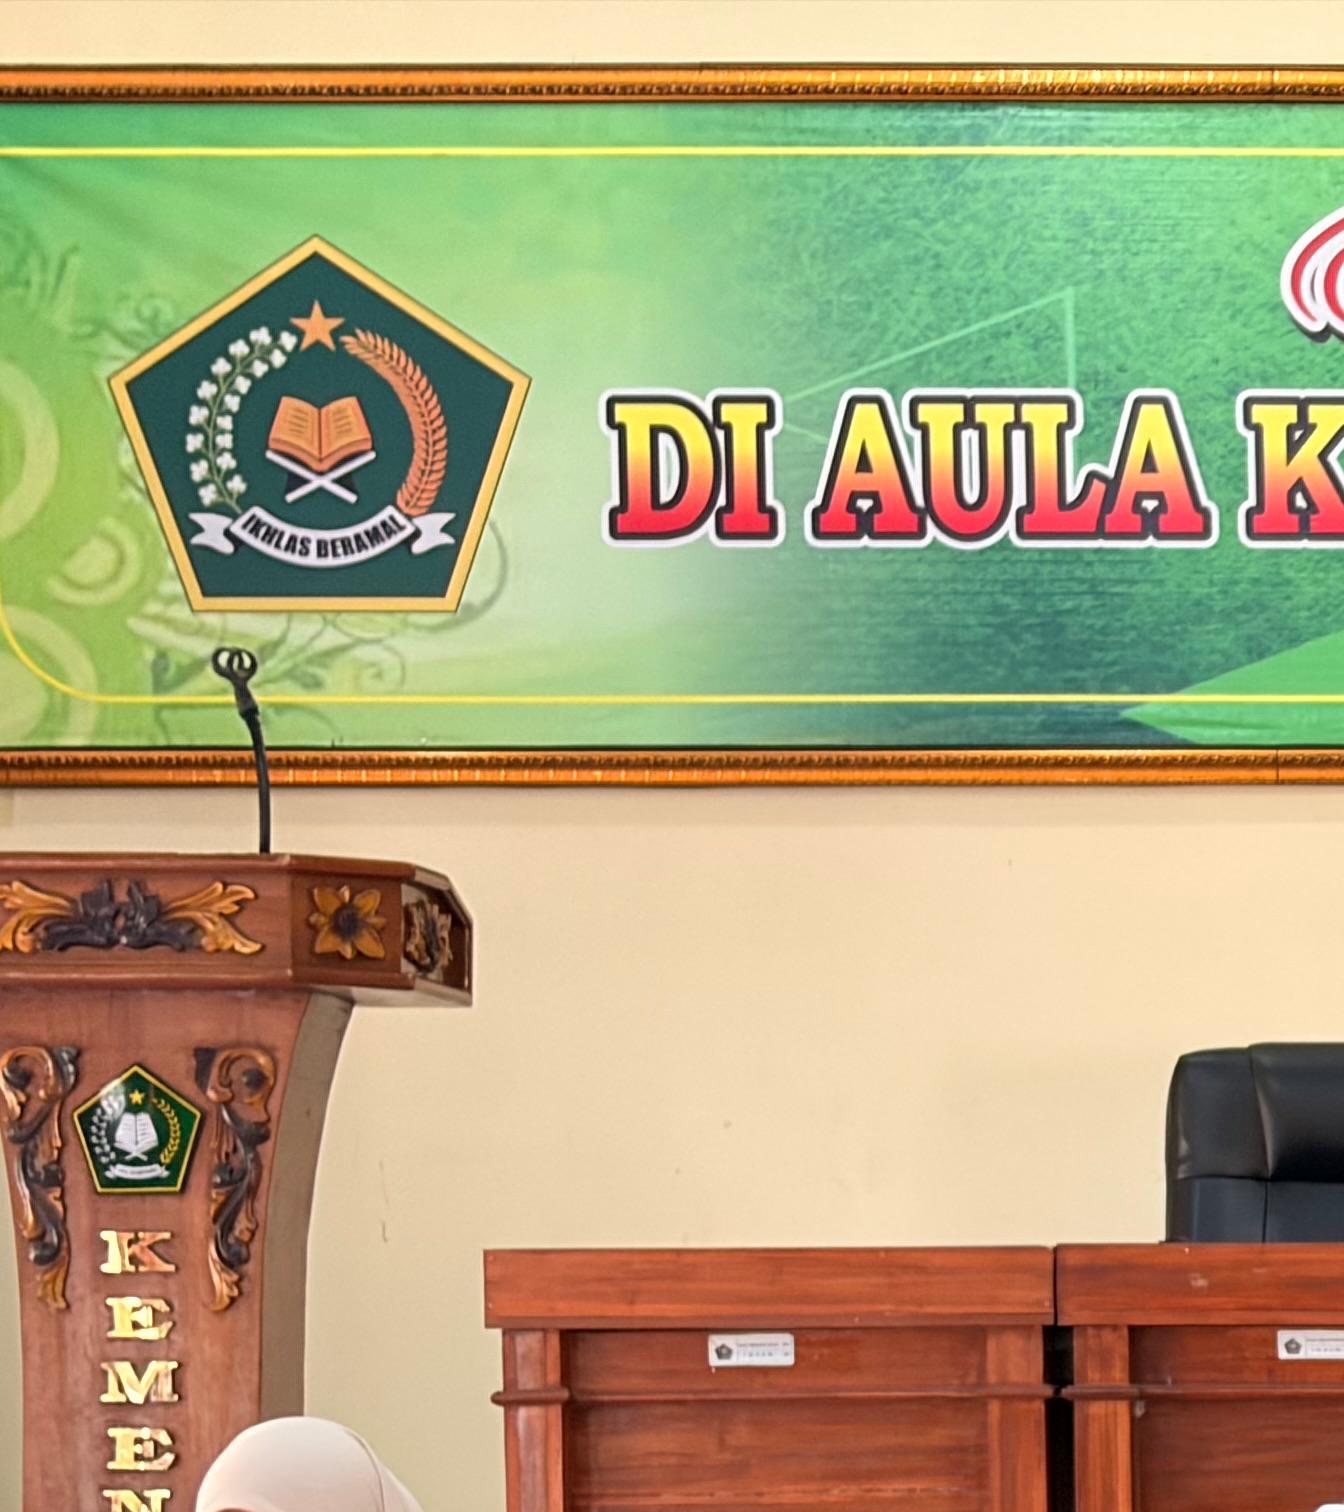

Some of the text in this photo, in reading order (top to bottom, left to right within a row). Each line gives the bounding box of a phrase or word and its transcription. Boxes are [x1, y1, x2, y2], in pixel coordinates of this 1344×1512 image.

[603, 391, 780, 544] DI
[808, 391, 1217, 544] AULA
[241, 514, 406, 559] IKHLAS BERAMAL
